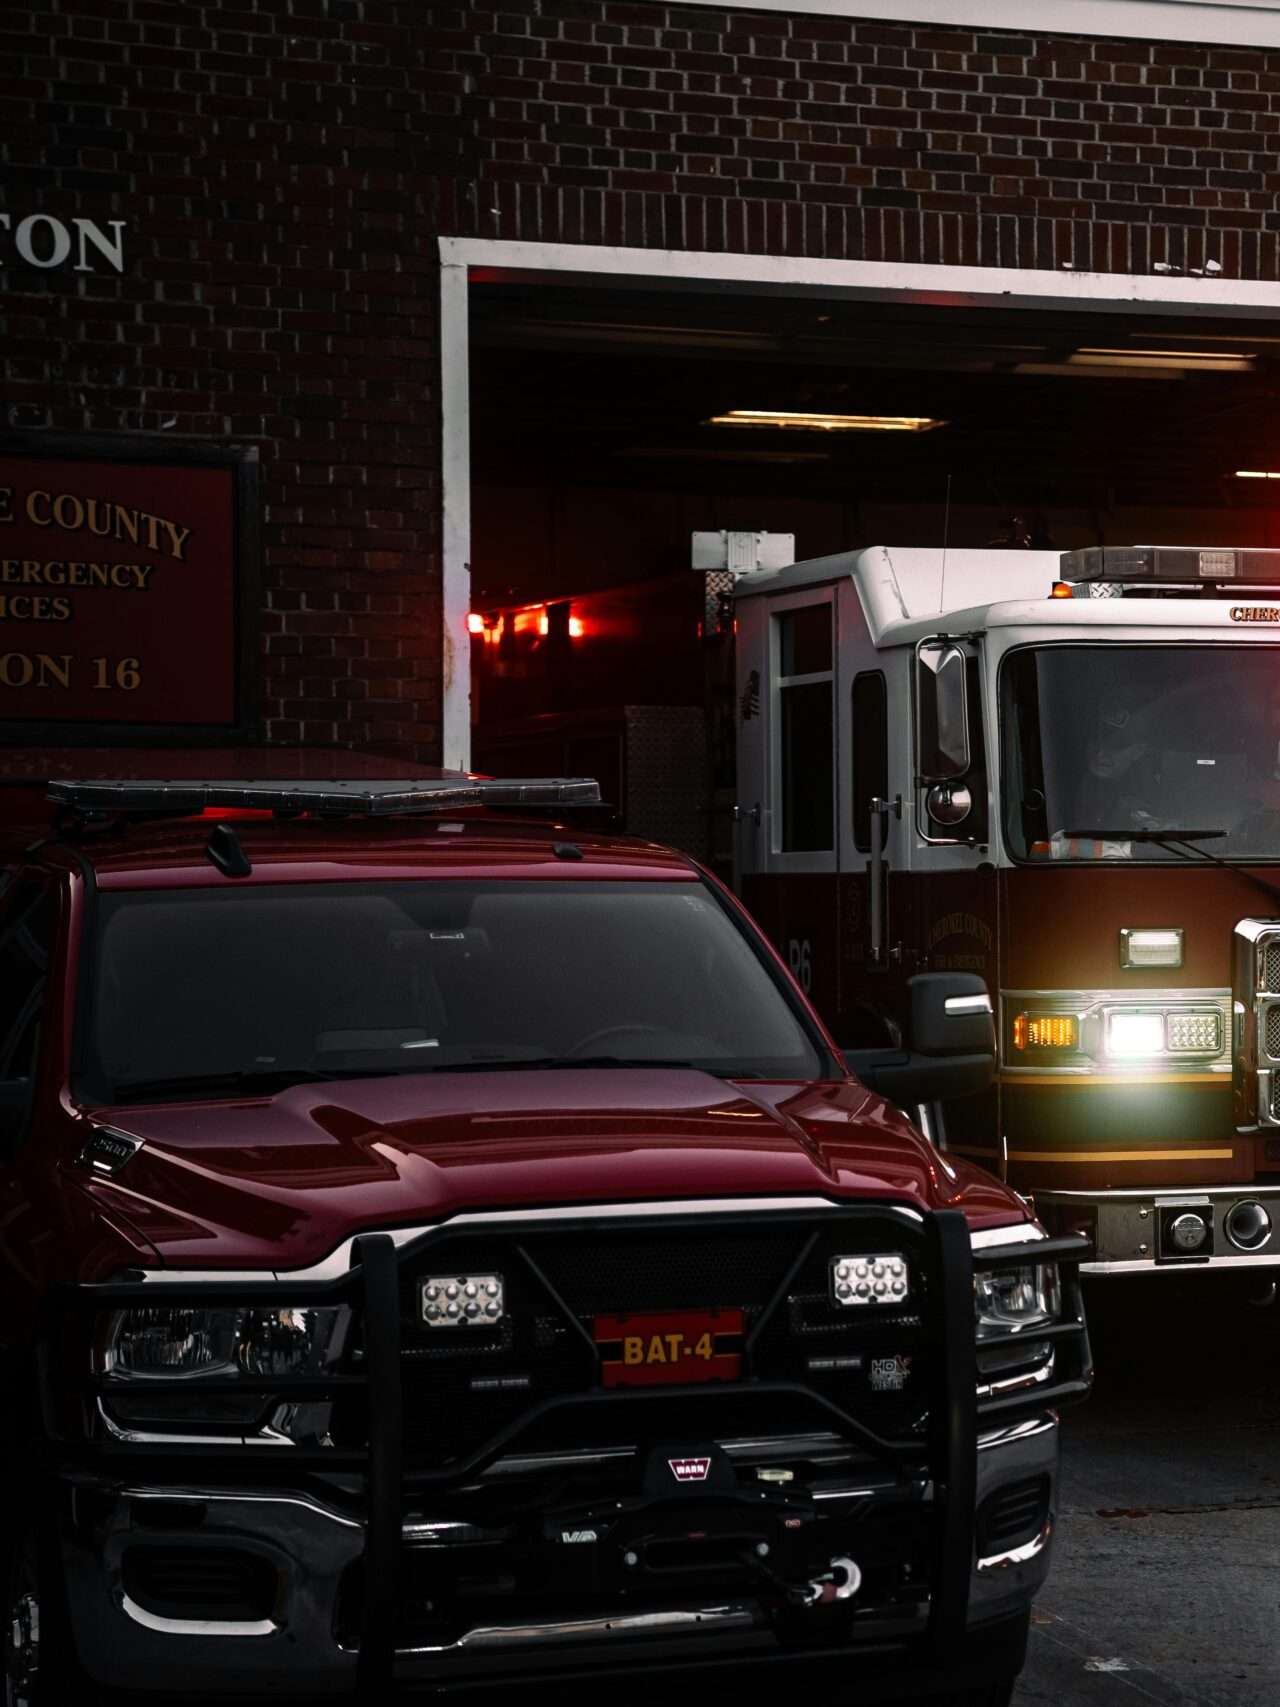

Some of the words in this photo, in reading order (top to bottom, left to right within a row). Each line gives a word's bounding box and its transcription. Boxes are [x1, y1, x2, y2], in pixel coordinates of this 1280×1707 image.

[0, 213, 127, 272] ON
[26, 490, 191, 560] COUNTY
[91, 656, 141, 690] 16
[623, 1332, 713, 1365] BAT-4
[676, 1464, 705, 1475] WARN
